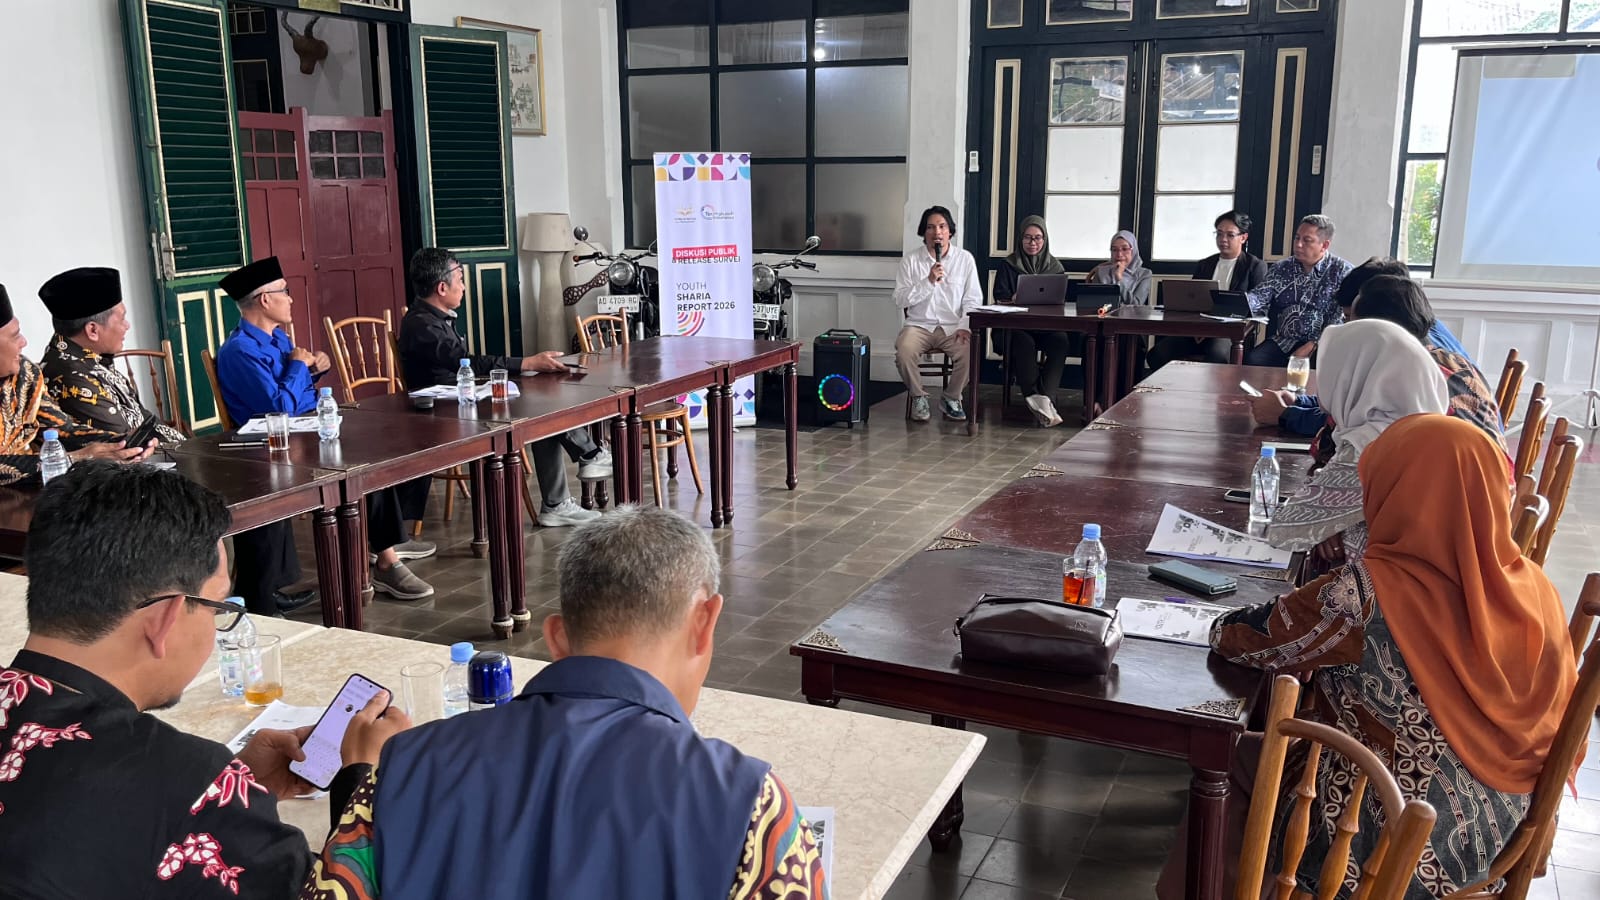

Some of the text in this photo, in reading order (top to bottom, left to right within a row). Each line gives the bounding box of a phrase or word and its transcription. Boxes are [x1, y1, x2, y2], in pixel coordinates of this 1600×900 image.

[675, 247, 736, 258] DISKUSI PUBLIK
[678, 256, 712, 265] RELEASE
[713, 255, 741, 264] SURVEI
[676, 282, 707, 291] YOUTH
[676, 292, 711, 301] SHARIA
[677, 301, 736, 311] REPORT 2026
